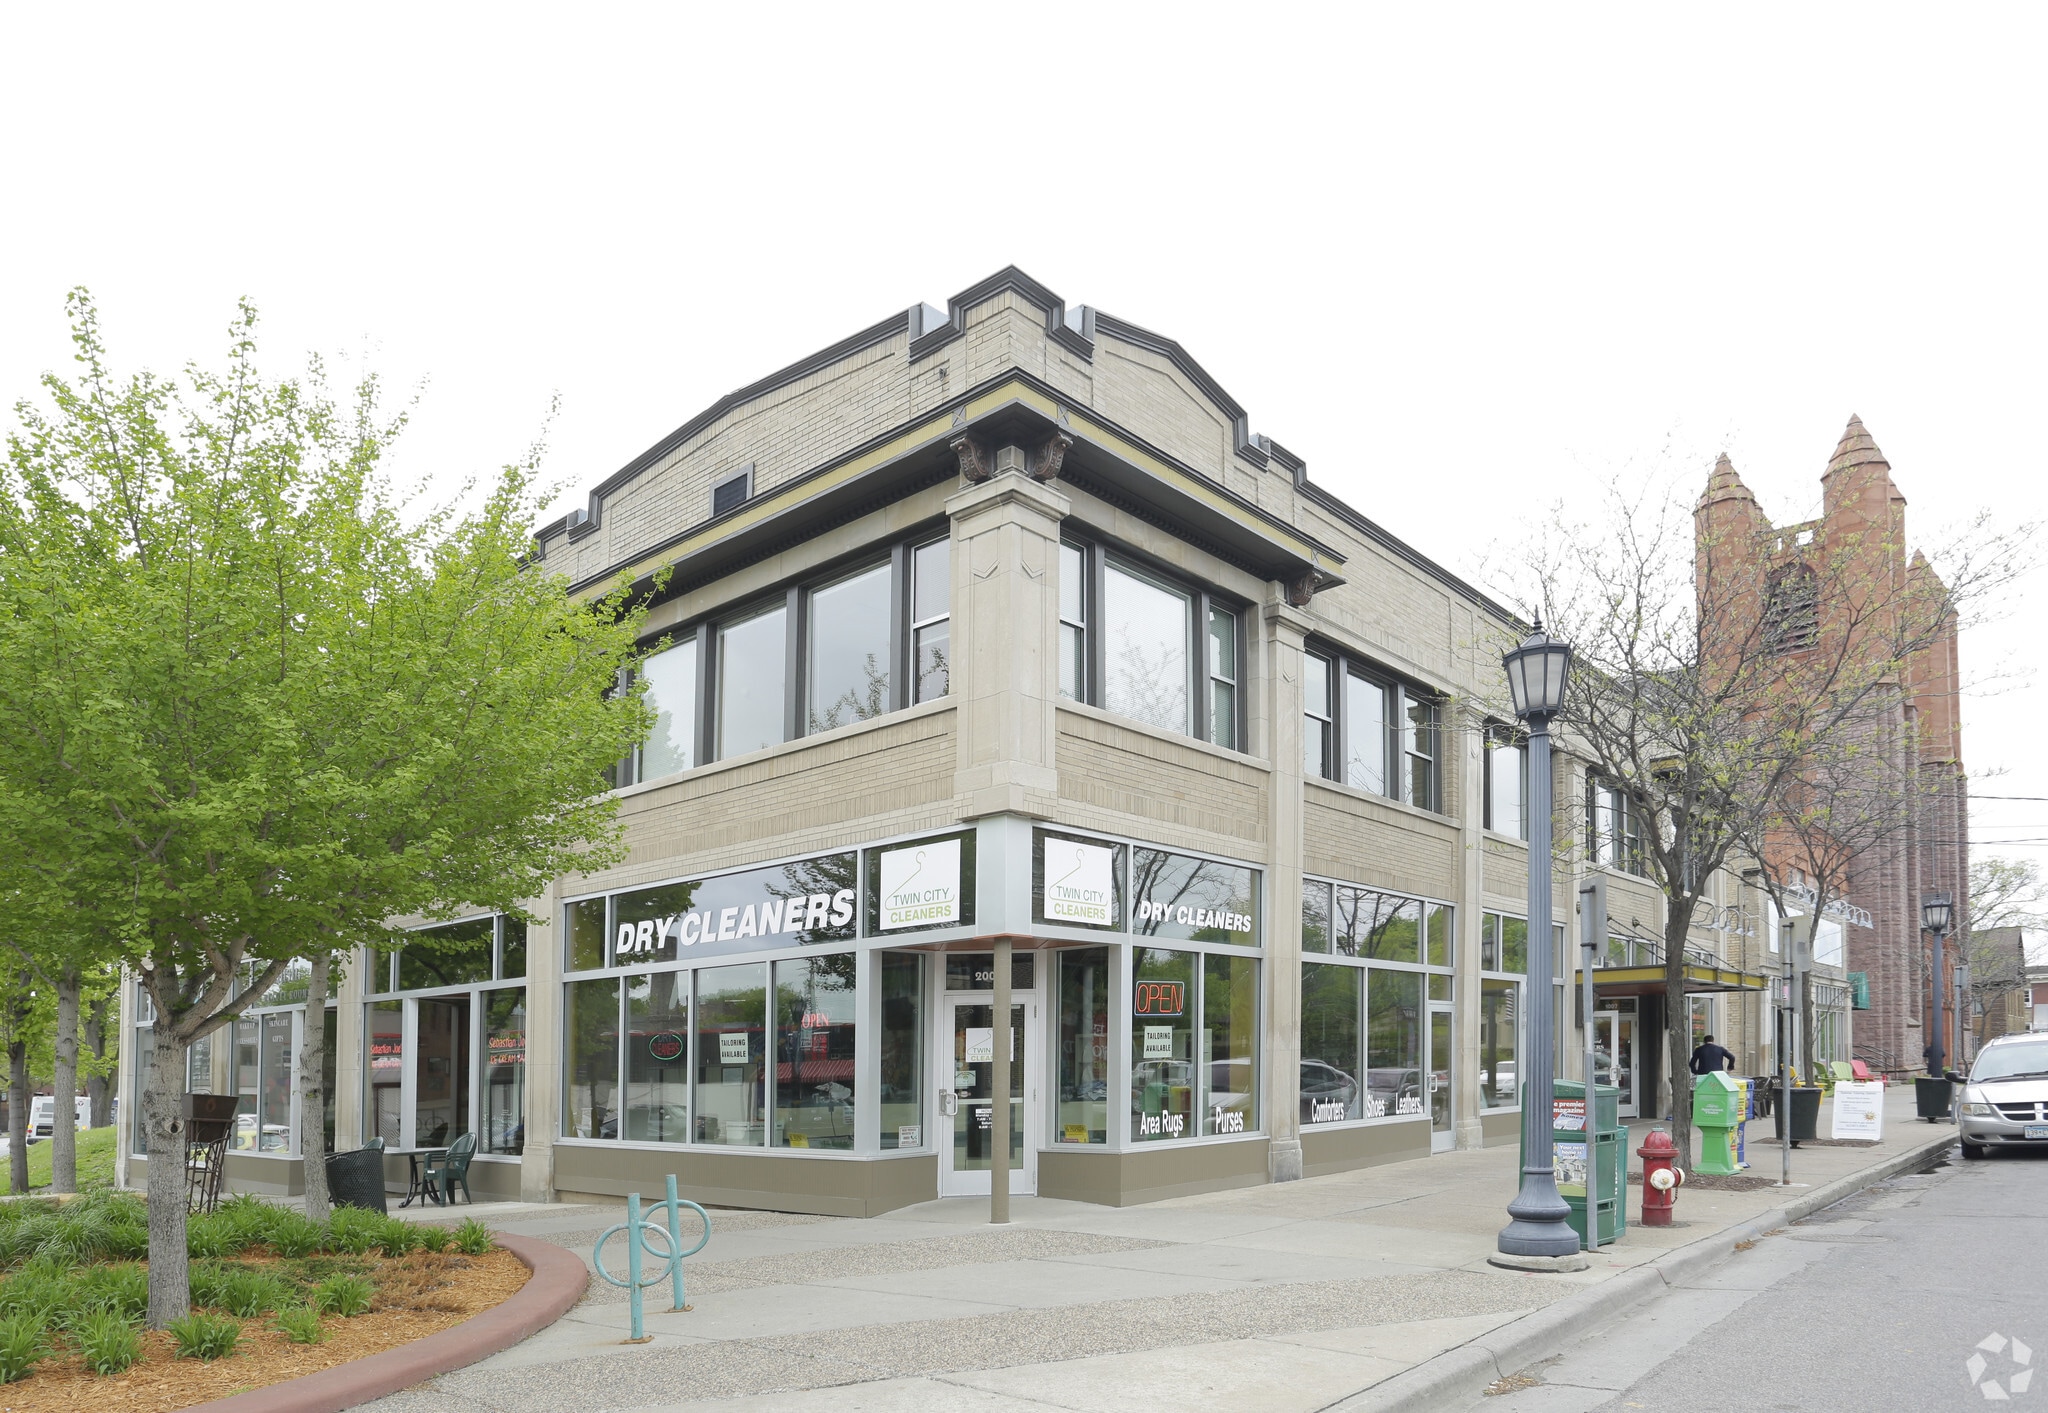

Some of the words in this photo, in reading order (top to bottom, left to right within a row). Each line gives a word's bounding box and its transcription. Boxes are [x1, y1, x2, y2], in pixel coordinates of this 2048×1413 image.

[893, 891, 921, 906] TWIN
[924, 887, 950, 904] CITY
[1056, 885, 1081, 900] TWIN
[1082, 887, 1104, 903] CITY
[890, 904, 952, 924] CLEANERS
[1054, 902, 1106, 920] CLEANERS
[1139, 900, 1174, 922] DRY
[1176, 905, 1252, 933] CLEANERS
[616, 915, 675, 954] DRY
[680, 888, 855, 947] CLEANERS
[1136, 983, 1183, 1014] OPEN
[801, 1013, 829, 1029] OPEN
[488, 1037, 517, 1048] Sebastian
[721, 1039, 746, 1047] TAILORING
[1147, 1032, 1171, 1040] TAILORING
[370, 1044, 392, 1055] Sebastian
[721, 1050, 746, 1058] AVAILABLE
[1146, 1044, 1171, 1052] AVAILABLE
[1312, 1097, 1345, 1123] Comforters
[1367, 1094, 1386, 1118] Shoes
[1140, 1111, 1160, 1135] Area
[1162, 1110, 1184, 1138] Rugs
[1215, 1106, 1244, 1133] Purses
